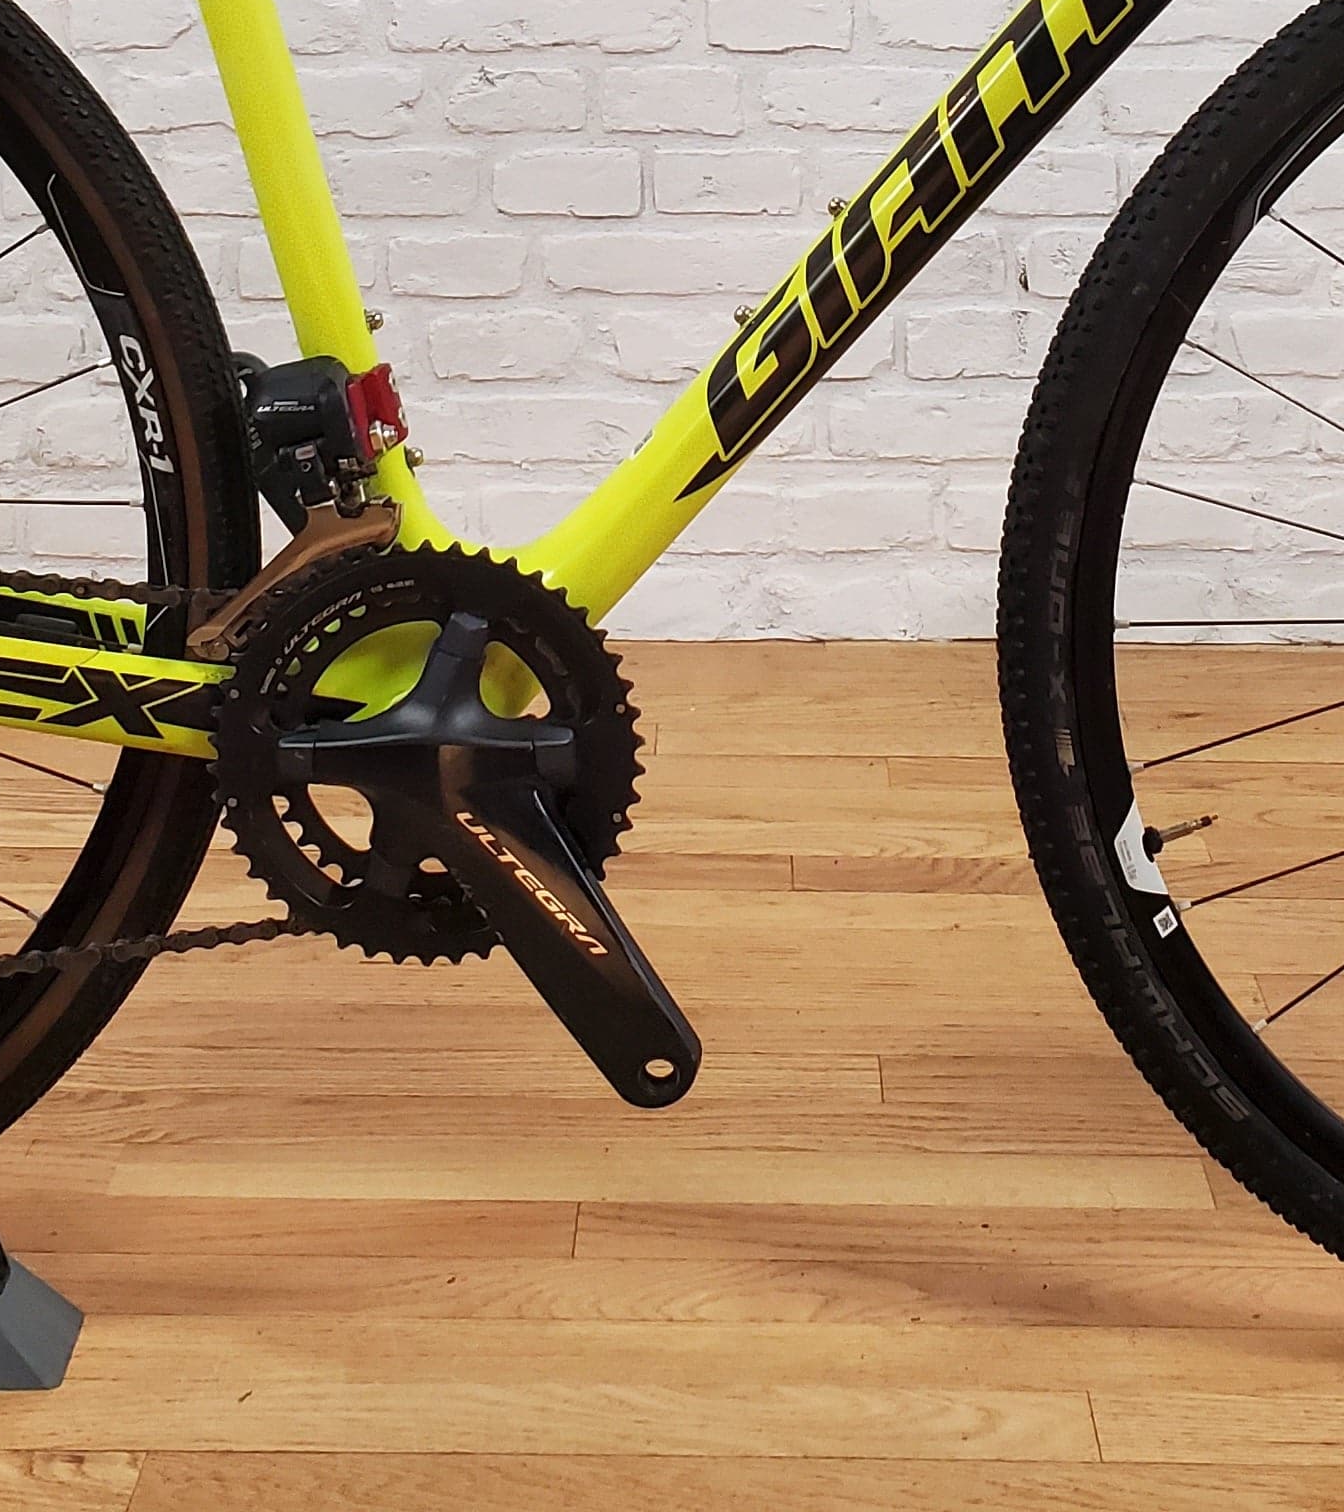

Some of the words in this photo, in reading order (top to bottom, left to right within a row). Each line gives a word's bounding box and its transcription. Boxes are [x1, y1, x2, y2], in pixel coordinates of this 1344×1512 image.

[118, 334, 175, 474] CXR-1
[283, 590, 364, 655] ULTEGRA
[455, 811, 610, 956] ULTEGRA
